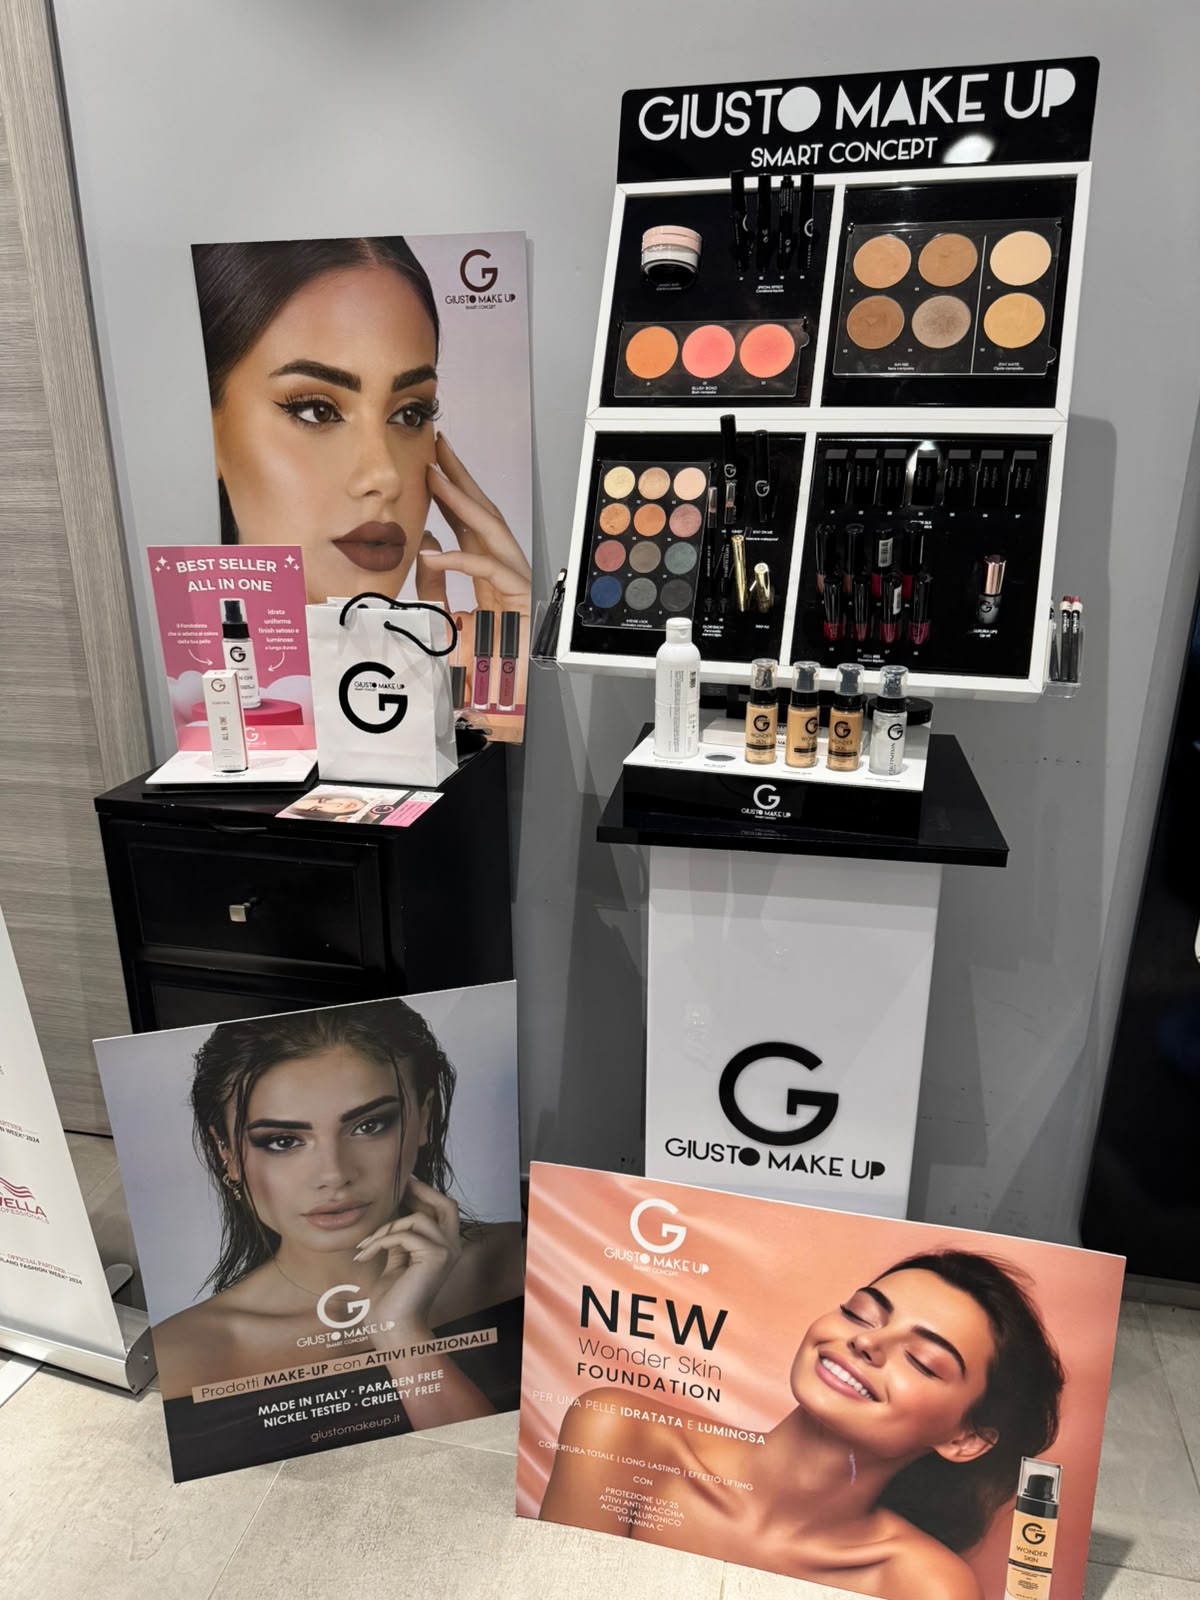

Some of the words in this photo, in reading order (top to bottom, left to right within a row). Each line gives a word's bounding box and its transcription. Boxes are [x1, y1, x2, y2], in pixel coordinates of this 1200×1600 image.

[638, 86, 821, 141] GIUSTO
[835, 73, 989, 130] MAKE
[1003, 67, 1076, 119] UP
[750, 142, 824, 168] SMART
[828, 137, 938, 164] CONCEPT
[460, 249, 498, 293] G
[445, 294, 477, 304] GIUSTO
[478, 294, 503, 303] MAKE
[505, 293, 516, 303] UP
[175, 559, 215, 574] BEST
[219, 558, 277, 573] SELLER
[188, 580, 216, 592] ALL
[218, 579, 234, 590] IN
[238, 579, 272, 592] ONE
[230, 646, 246, 662] G
[211, 678, 226, 692] G
[338, 661, 408, 734] G
[753, 715, 770, 732] G
[834, 721, 851, 738] G
[887, 723, 903, 740] G
[753, 784, 781, 810] G
[718, 1041, 839, 1146] G
[665, 1138, 760, 1166] GIUSTO
[768, 1150, 844, 1177] MAKE
[851, 1159, 886, 1180] UP
[630, 1198, 687, 1254] G
[603, 1246, 650, 1265] GIUSTO
[653, 1255, 689, 1272] MAKE
[692, 1261, 709, 1275] UP
[316, 1284, 370, 1329] G
[580, 1284, 729, 1351] NEW
[296, 1331, 341, 1349] GIUSTO
[343, 1323, 378, 1339] MAKE
[379, 1320, 395, 1333] UP
[201, 1377, 260, 1398] Prodotti
[263, 1364, 328, 1386] MAKE-UP
[333, 1357, 362, 1372] con
[365, 1349, 406, 1365] ATTIVI
[409, 1332, 490, 1357] FUNZIONALI
[578, 1337, 671, 1370] Wonder
[678, 1355, 722, 1381] Skin
[258, 1400, 296, 1416] MADE
[298, 1397, 312, 1408] IN
[315, 1388, 348, 1405] ITALY
[358, 1375, 415, 1396] PARABEN
[417, 1369, 444, 1382] FREE
[576, 1362, 721, 1403] FOUNDATION
[263, 1411, 308, 1428] NICKEL
[312, 1402, 351, 1418] TESTED
[361, 1387, 411, 1408] CRUELTY
[414, 1383, 441, 1396] FREE
[532, 1390, 552, 1402] PER
[557, 1394, 581, 1408] UNA
[586, 1399, 617, 1415] PELLE
[620, 1407, 683, 1428] IDRATATA
[687, 1420, 693, 1430] E
[697, 1421, 766, 1445] LUMINOSA
[310, 1413, 401, 1443] giustomakeup.it
[538, 1440, 585, 1456] COPERTURA
[587, 1448, 615, 1462] TOTALE
[621, 1456, 646, 1468] LONG
[648, 1461, 681, 1475] LASTING
[688, 1470, 721, 1484] EFFETTO
[722, 1477, 754, 1491] LIFTING
[633, 1476, 653, 1486] CON
[599, 1495, 622, 1507] ATTIVI
[605, 1487, 654, 1503] PROTEZIONE
[656, 1494, 668, 1506] UV
[669, 1499, 679, 1509] 25
[600, 1503, 628, 1515] ACIDO
[630, 1509, 682, 1527] IALURONICO
[617, 1515, 655, 1531] VITAMINA
[656, 1523, 664, 1532] C
[1022, 1522, 1046, 1544] G
[1016, 1545, 1048, 1557] WONDER
[1024, 1555, 1039, 1563] SKIN
